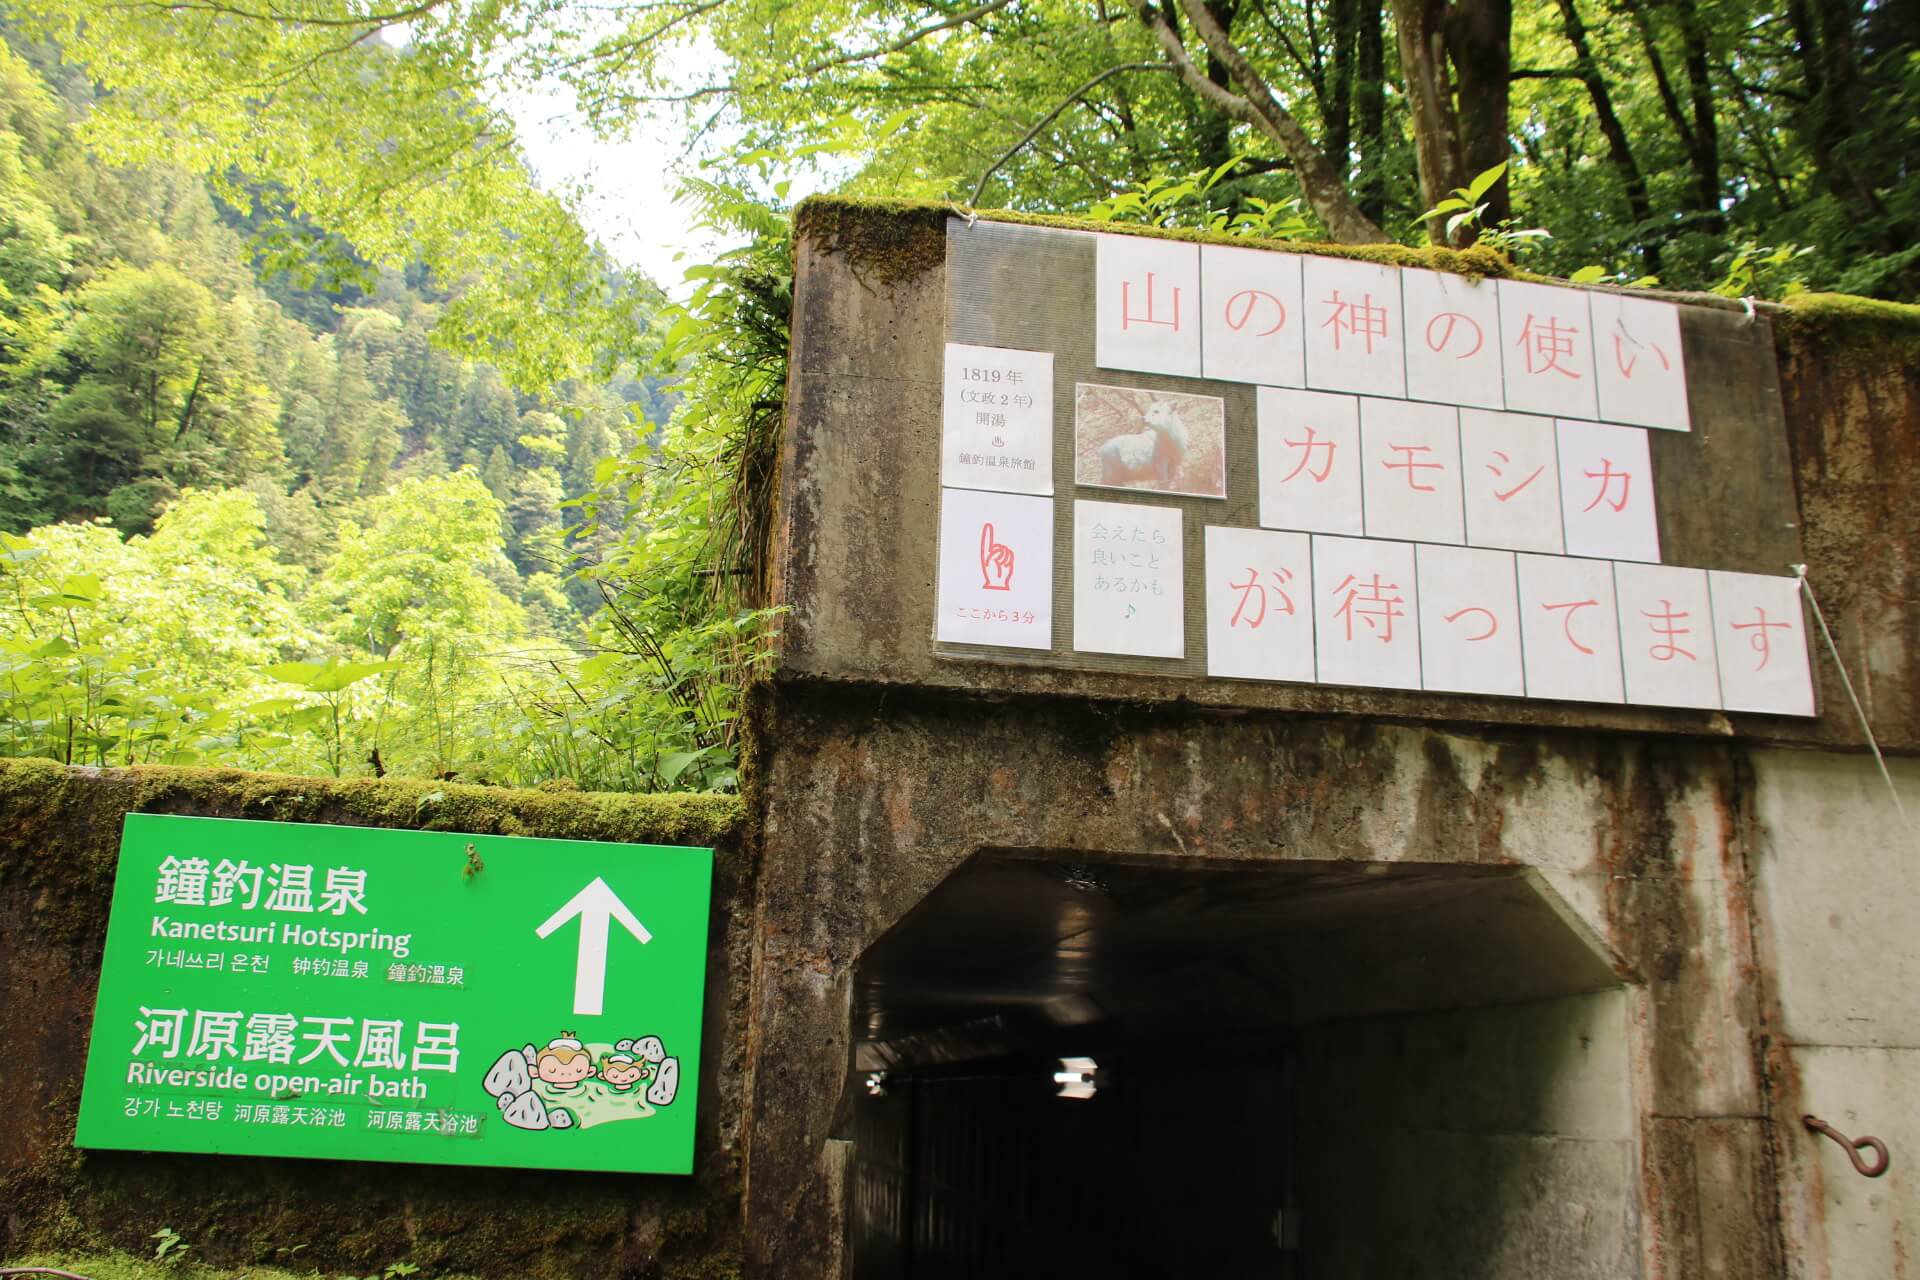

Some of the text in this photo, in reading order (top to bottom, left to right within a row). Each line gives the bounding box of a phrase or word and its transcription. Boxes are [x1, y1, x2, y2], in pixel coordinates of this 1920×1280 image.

[1120, 270, 1671, 380] 山の神の使い
[1281, 425, 1632, 514] カモシカ
[1091, 523, 1167, 545] 会えたら
[1091, 547, 1161, 570] 良いこと
[1093, 575, 1165, 596] あるかも
[1229, 565, 1792, 671] が待ってます
[154, 855, 368, 916] 鐘釣温泉
[151, 916, 412, 958] Kanetsuri Hotspring
[145, 948, 270, 974] 가네쓰리 온천
[292, 955, 369, 979] 钟钓温泉
[131, 1005, 460, 1074] 河原露天風呂
[127, 1062, 428, 1101] Riverside open-air bath
[124, 1096, 224, 1121] 강가 노천탕
[234, 1103, 346, 1128] 河原露天浴池
[367, 1109, 478, 1134] 河原露天浴池
